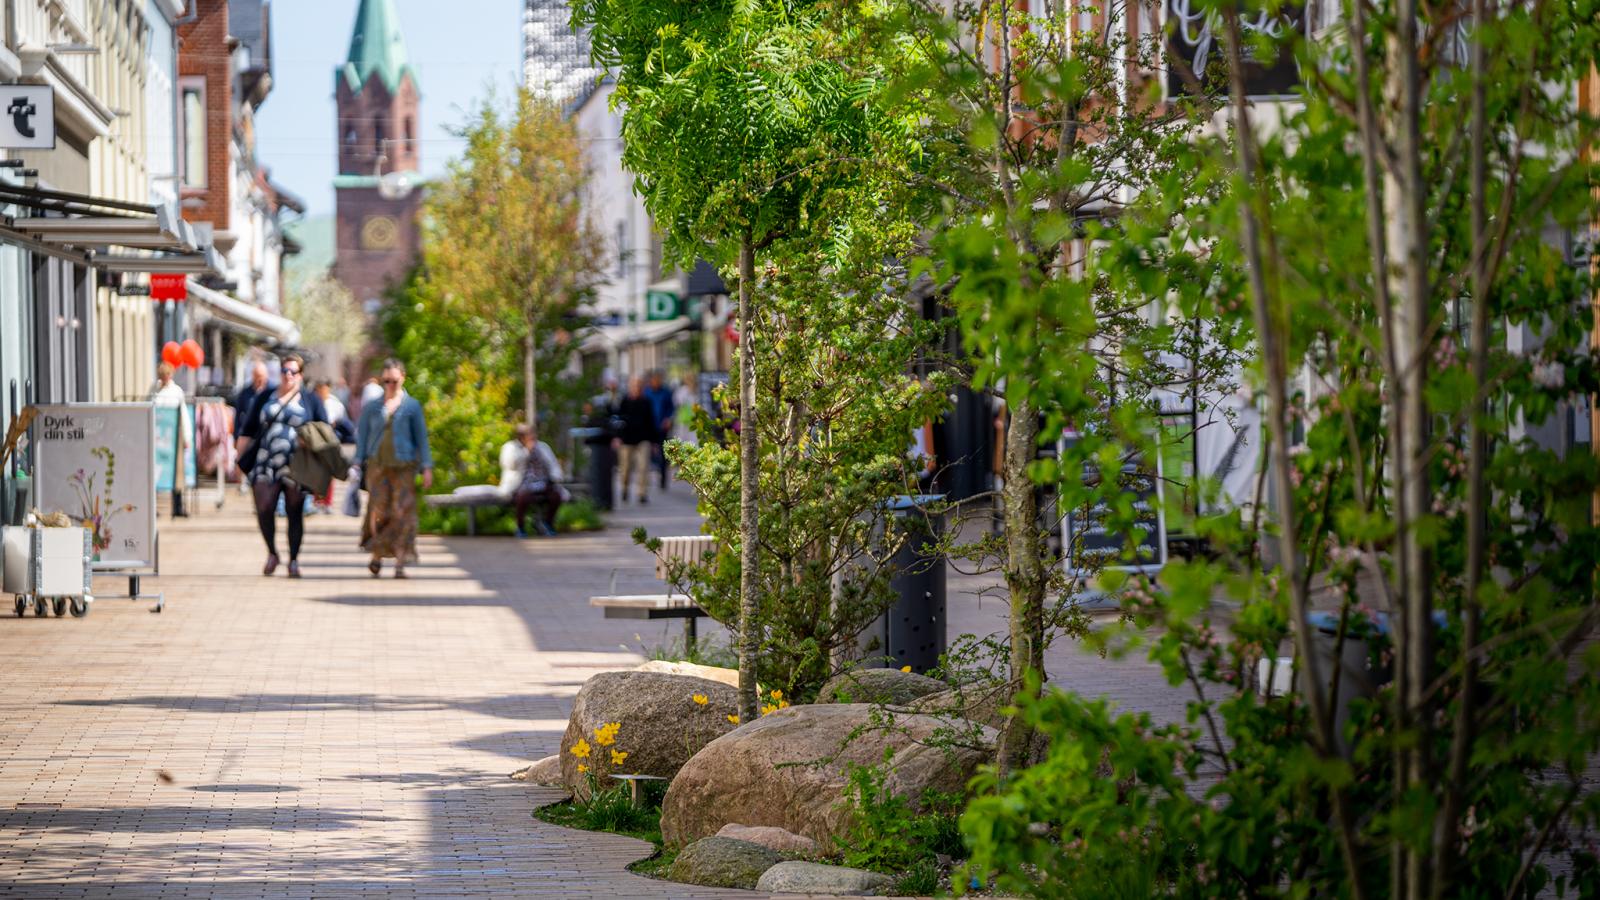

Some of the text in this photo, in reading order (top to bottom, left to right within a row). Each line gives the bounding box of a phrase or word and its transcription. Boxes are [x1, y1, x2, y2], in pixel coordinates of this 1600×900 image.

[44, 415, 74, 430] Dyrk
[44, 427, 85, 440] din stil
